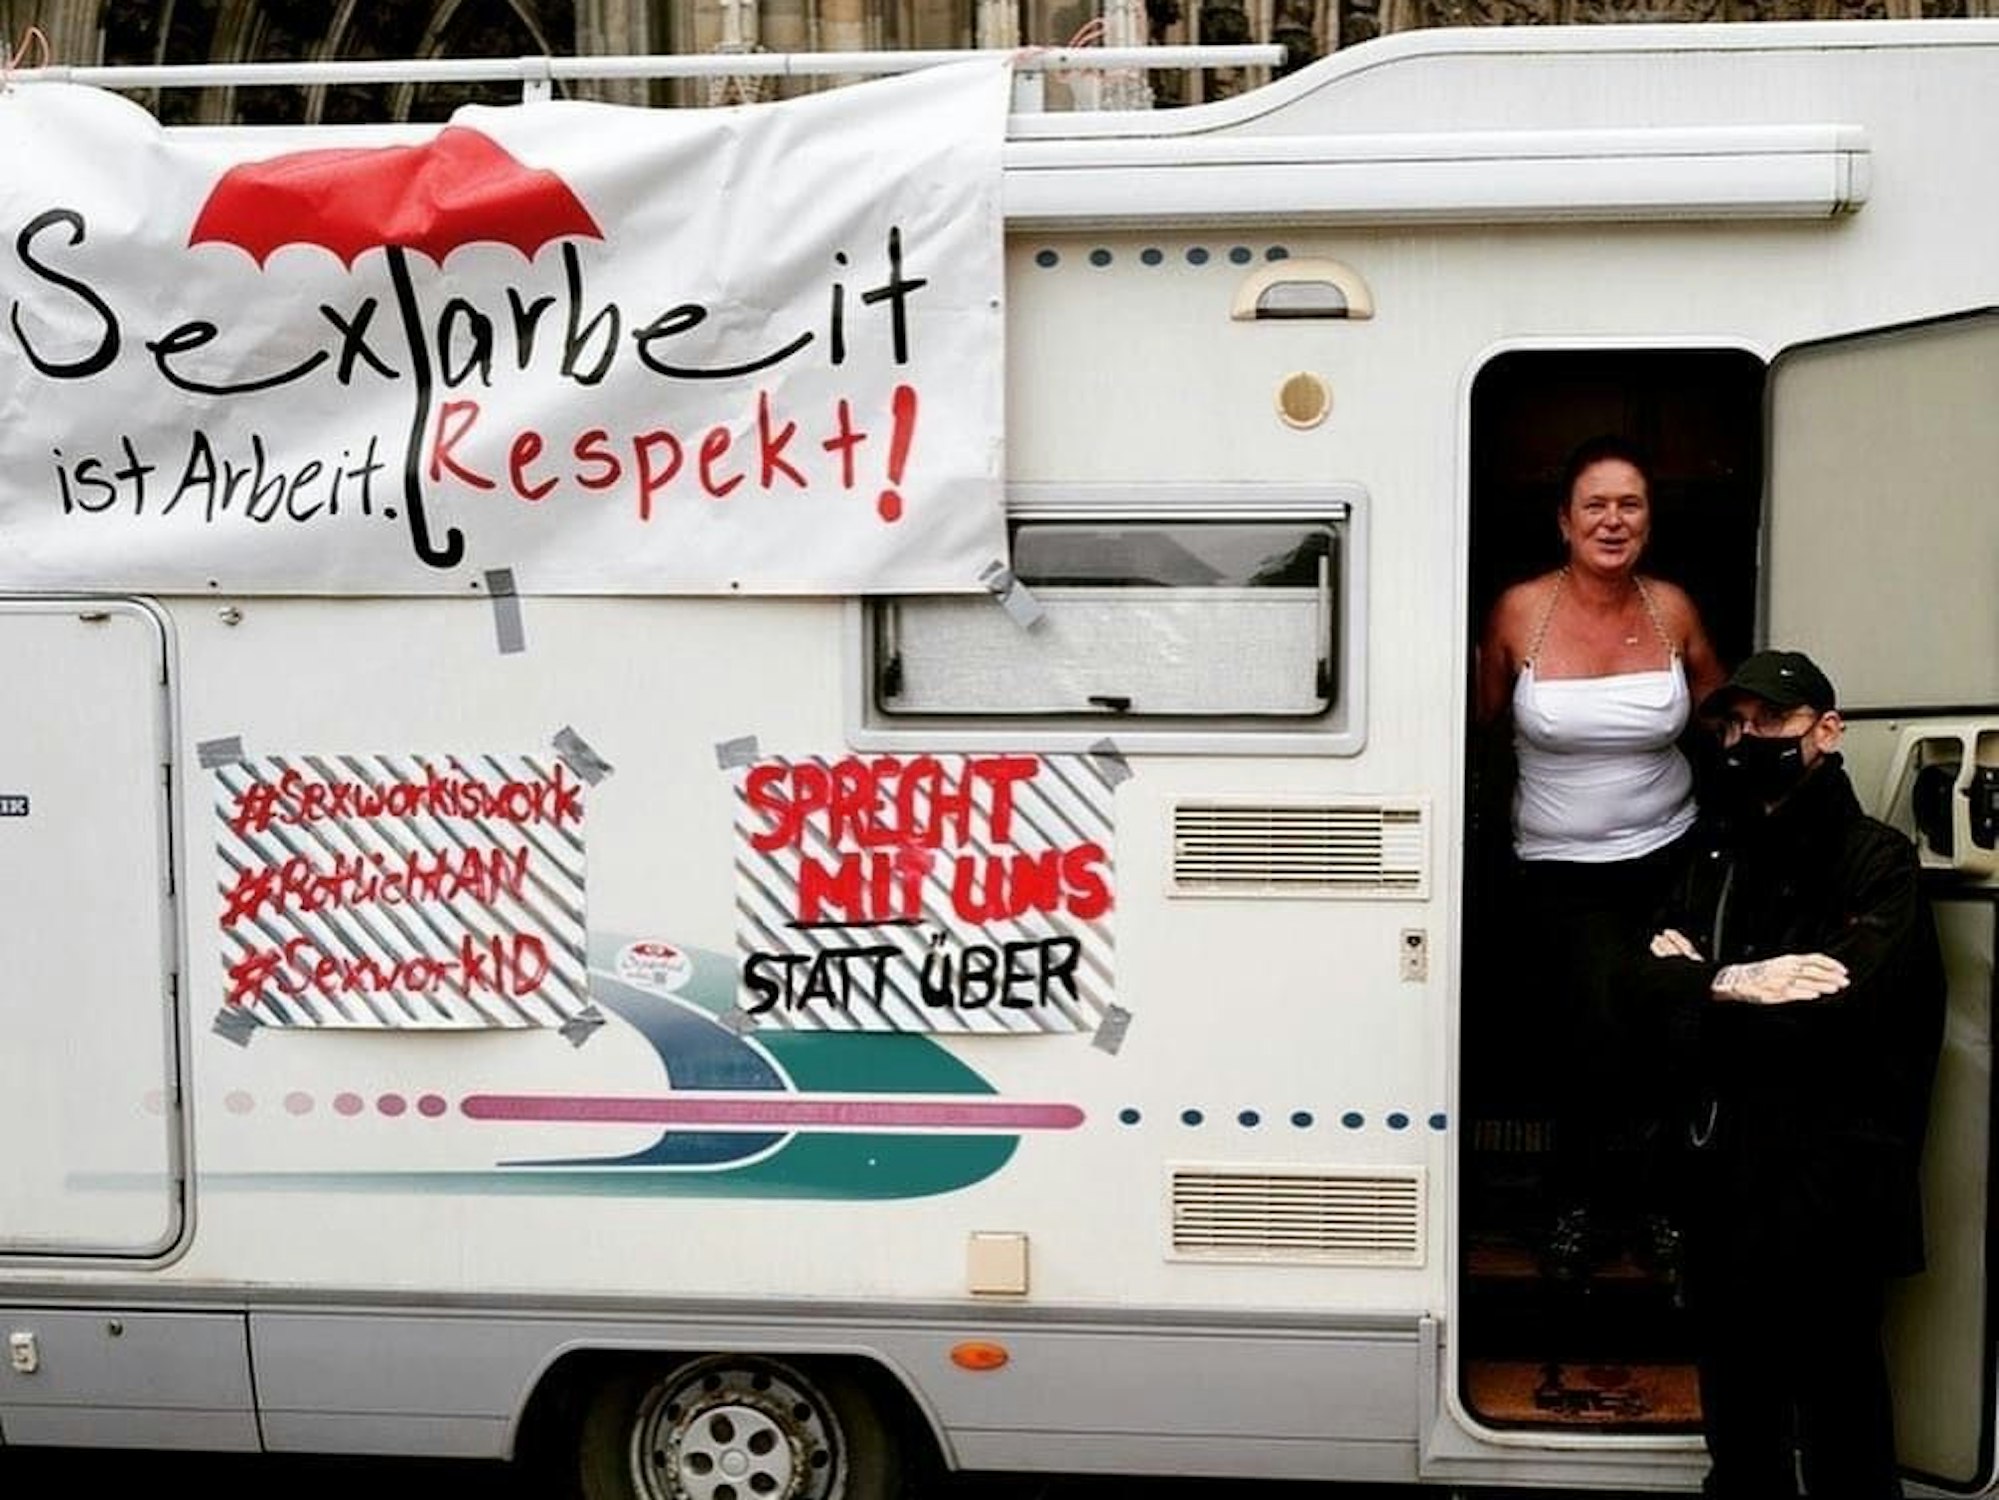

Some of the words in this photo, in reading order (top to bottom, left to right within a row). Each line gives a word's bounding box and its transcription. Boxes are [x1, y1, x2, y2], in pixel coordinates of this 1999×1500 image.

[52, 436, 155, 517] ist
[170, 430, 399, 523] Arbeit.
[430, 384, 918, 523] Respekt!
[232, 763, 585, 833] #Sexworkiswork
[746, 754, 1039, 852] SPRECHT
[799, 849, 931, 926] MIT
[953, 844, 1112, 925] UNS
[227, 934, 550, 1008] #SexworkID
[744, 946, 902, 1014] STATT
[920, 933, 1081, 1010] ÜBER
